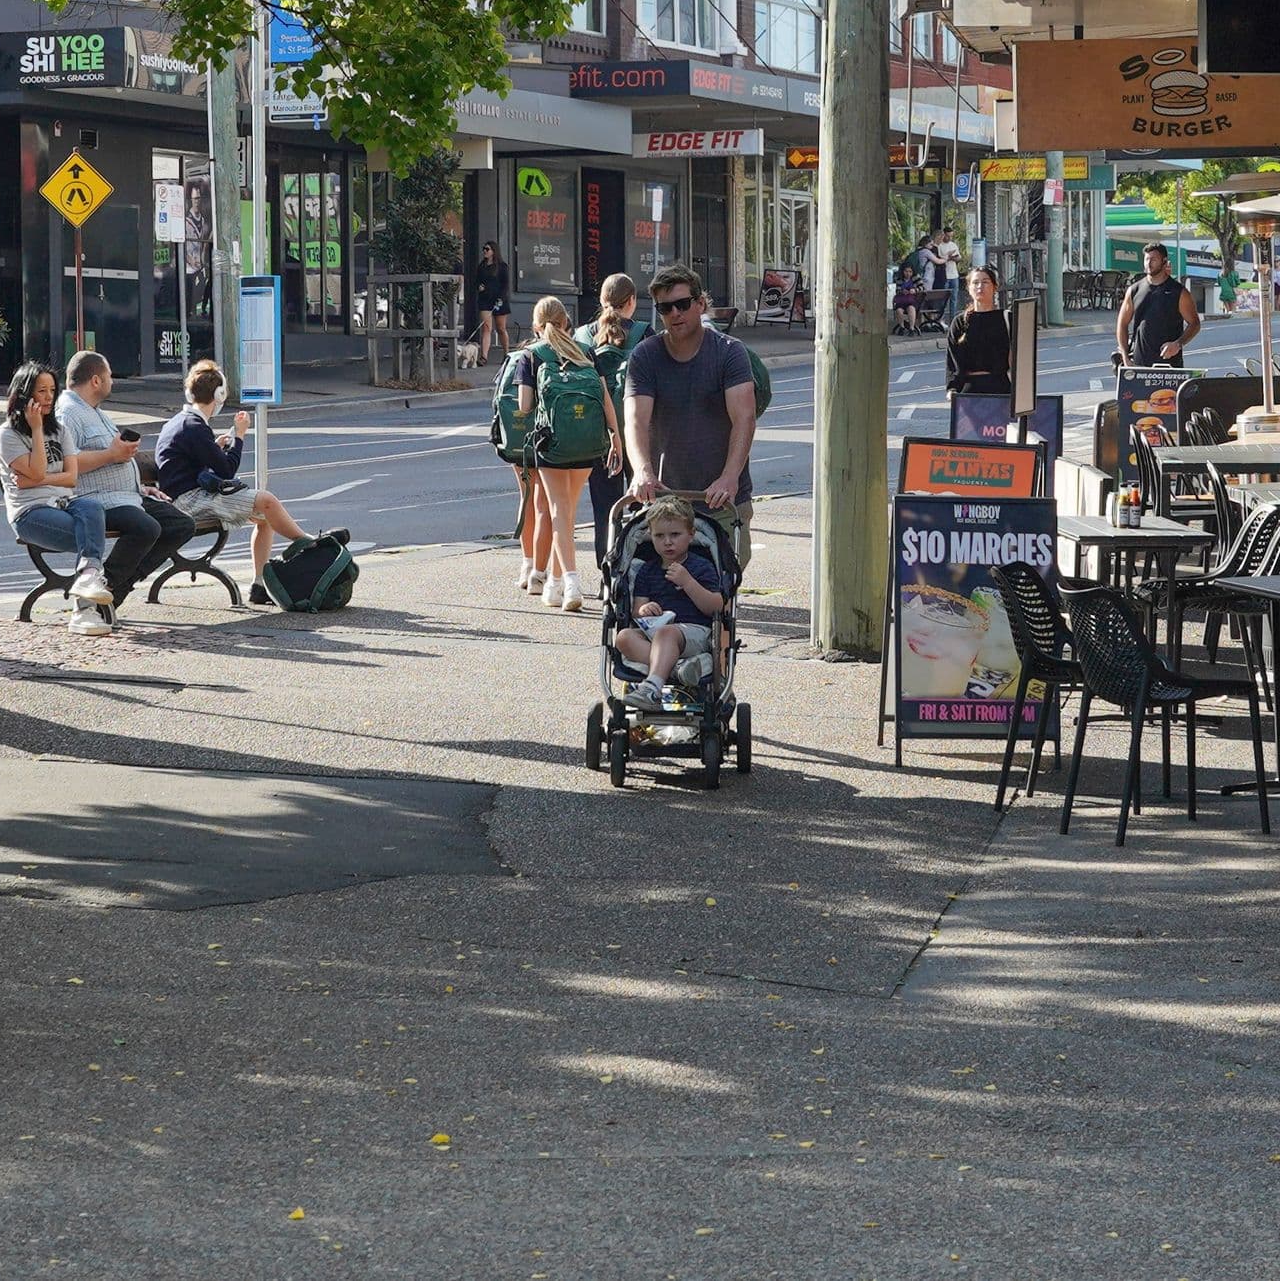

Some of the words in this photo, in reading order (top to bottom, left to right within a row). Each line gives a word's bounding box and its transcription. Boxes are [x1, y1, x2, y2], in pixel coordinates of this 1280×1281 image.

[26, 36, 55, 55] SU
[57, 34, 105, 53] YOO
[20, 54, 55, 73] SHI
[61, 52, 105, 72] HEE
[20, 75, 61, 85] GOODNESS
[66, 73, 105, 83] GRACIOUS
[1122, 94, 1145, 104] PLANT
[1215, 92, 1238, 103] BASED
[1132, 114, 1232, 137] BURGER
[647, 132, 706, 152] EDGE
[710, 130, 745, 149] FIT
[587, 183, 600, 224] EDGE
[527, 209, 551, 229] EDGE
[587, 229, 601, 252] FIT
[902, 527, 946, 566] $10
[919, 704, 937, 720] FRI
[939, 704, 949, 720] &
[951, 705, 973, 721] SAT
[975, 705, 1007, 722] FROM
